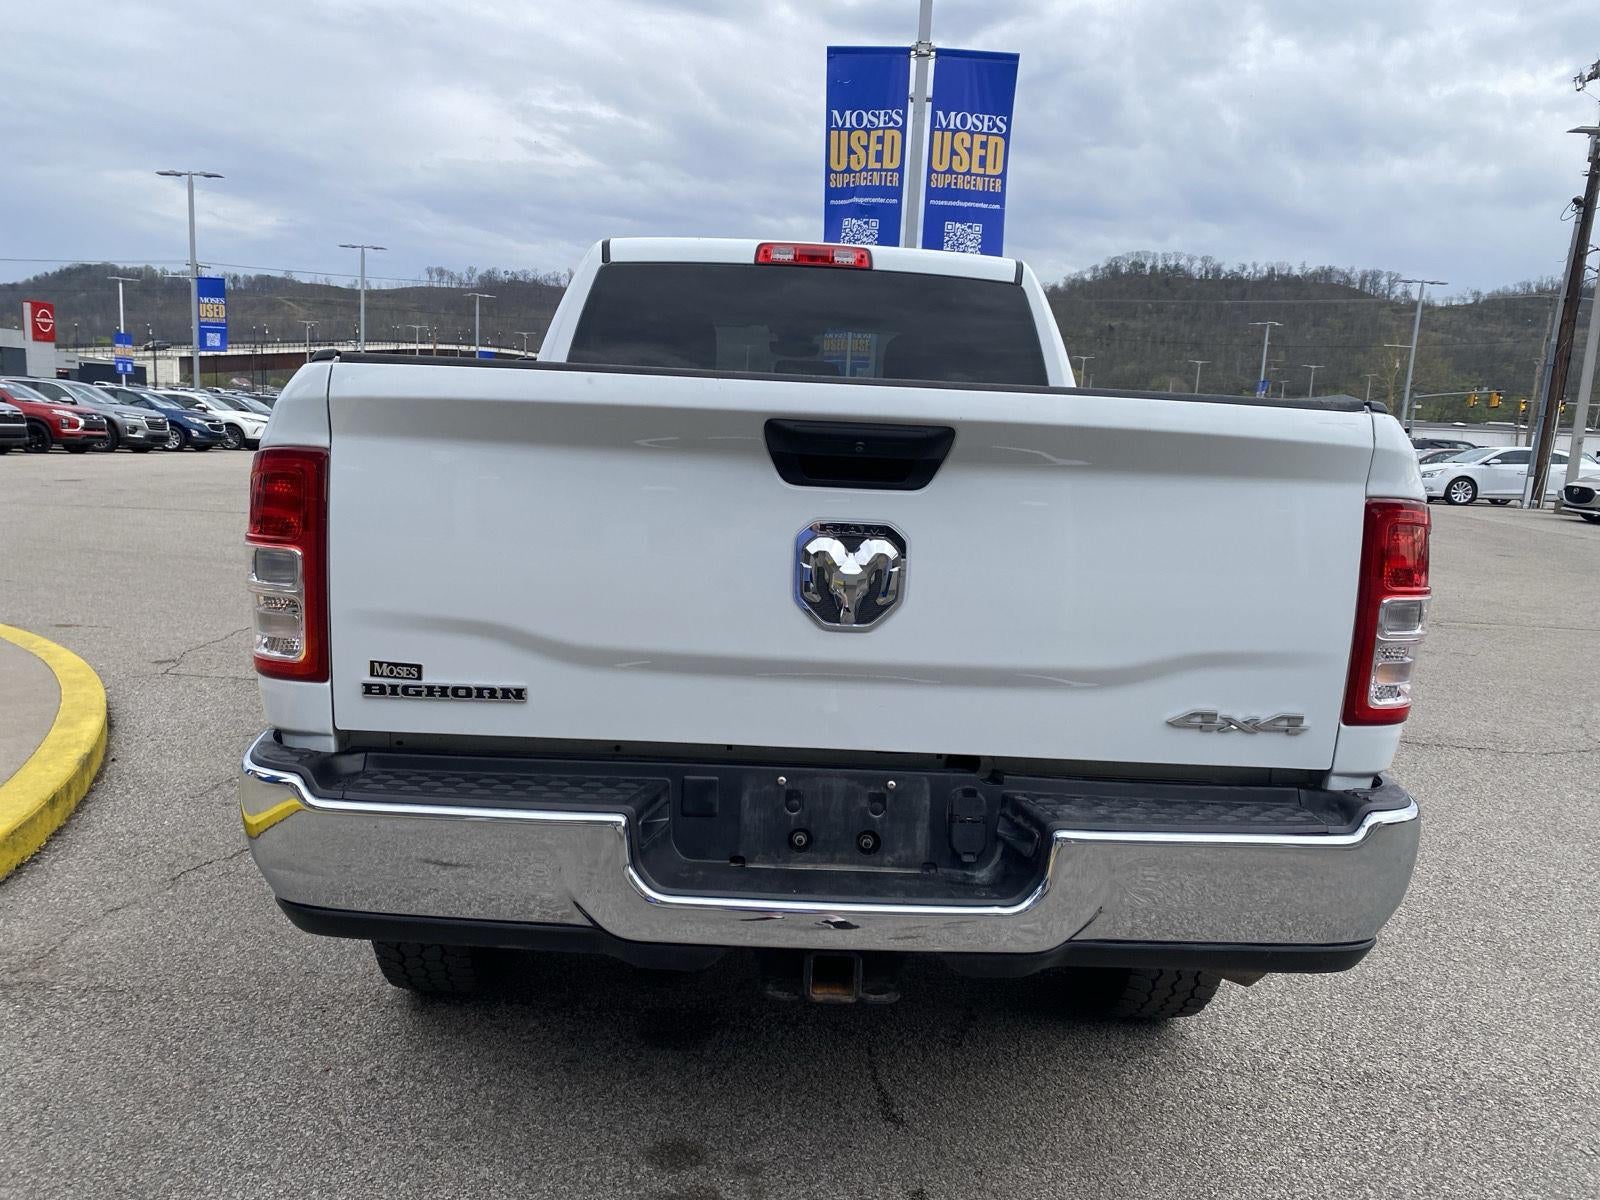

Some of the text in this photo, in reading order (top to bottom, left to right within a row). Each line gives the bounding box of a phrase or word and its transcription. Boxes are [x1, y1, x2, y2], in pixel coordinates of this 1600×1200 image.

[830, 108, 904, 129] MOSES
[934, 110, 1008, 134] MOSES
[829, 129, 903, 172] USED
[931, 131, 1006, 176] USED
[829, 171, 899, 188] SUPERCENTER
[930, 173, 1002, 193] SUPERCENTER
[929, 199, 1001, 210] mosesusedsupercenter.com
[199, 296, 226, 304] MOSES
[199, 303, 226, 318] USED
[361, 682, 528, 702] BIGHORN
